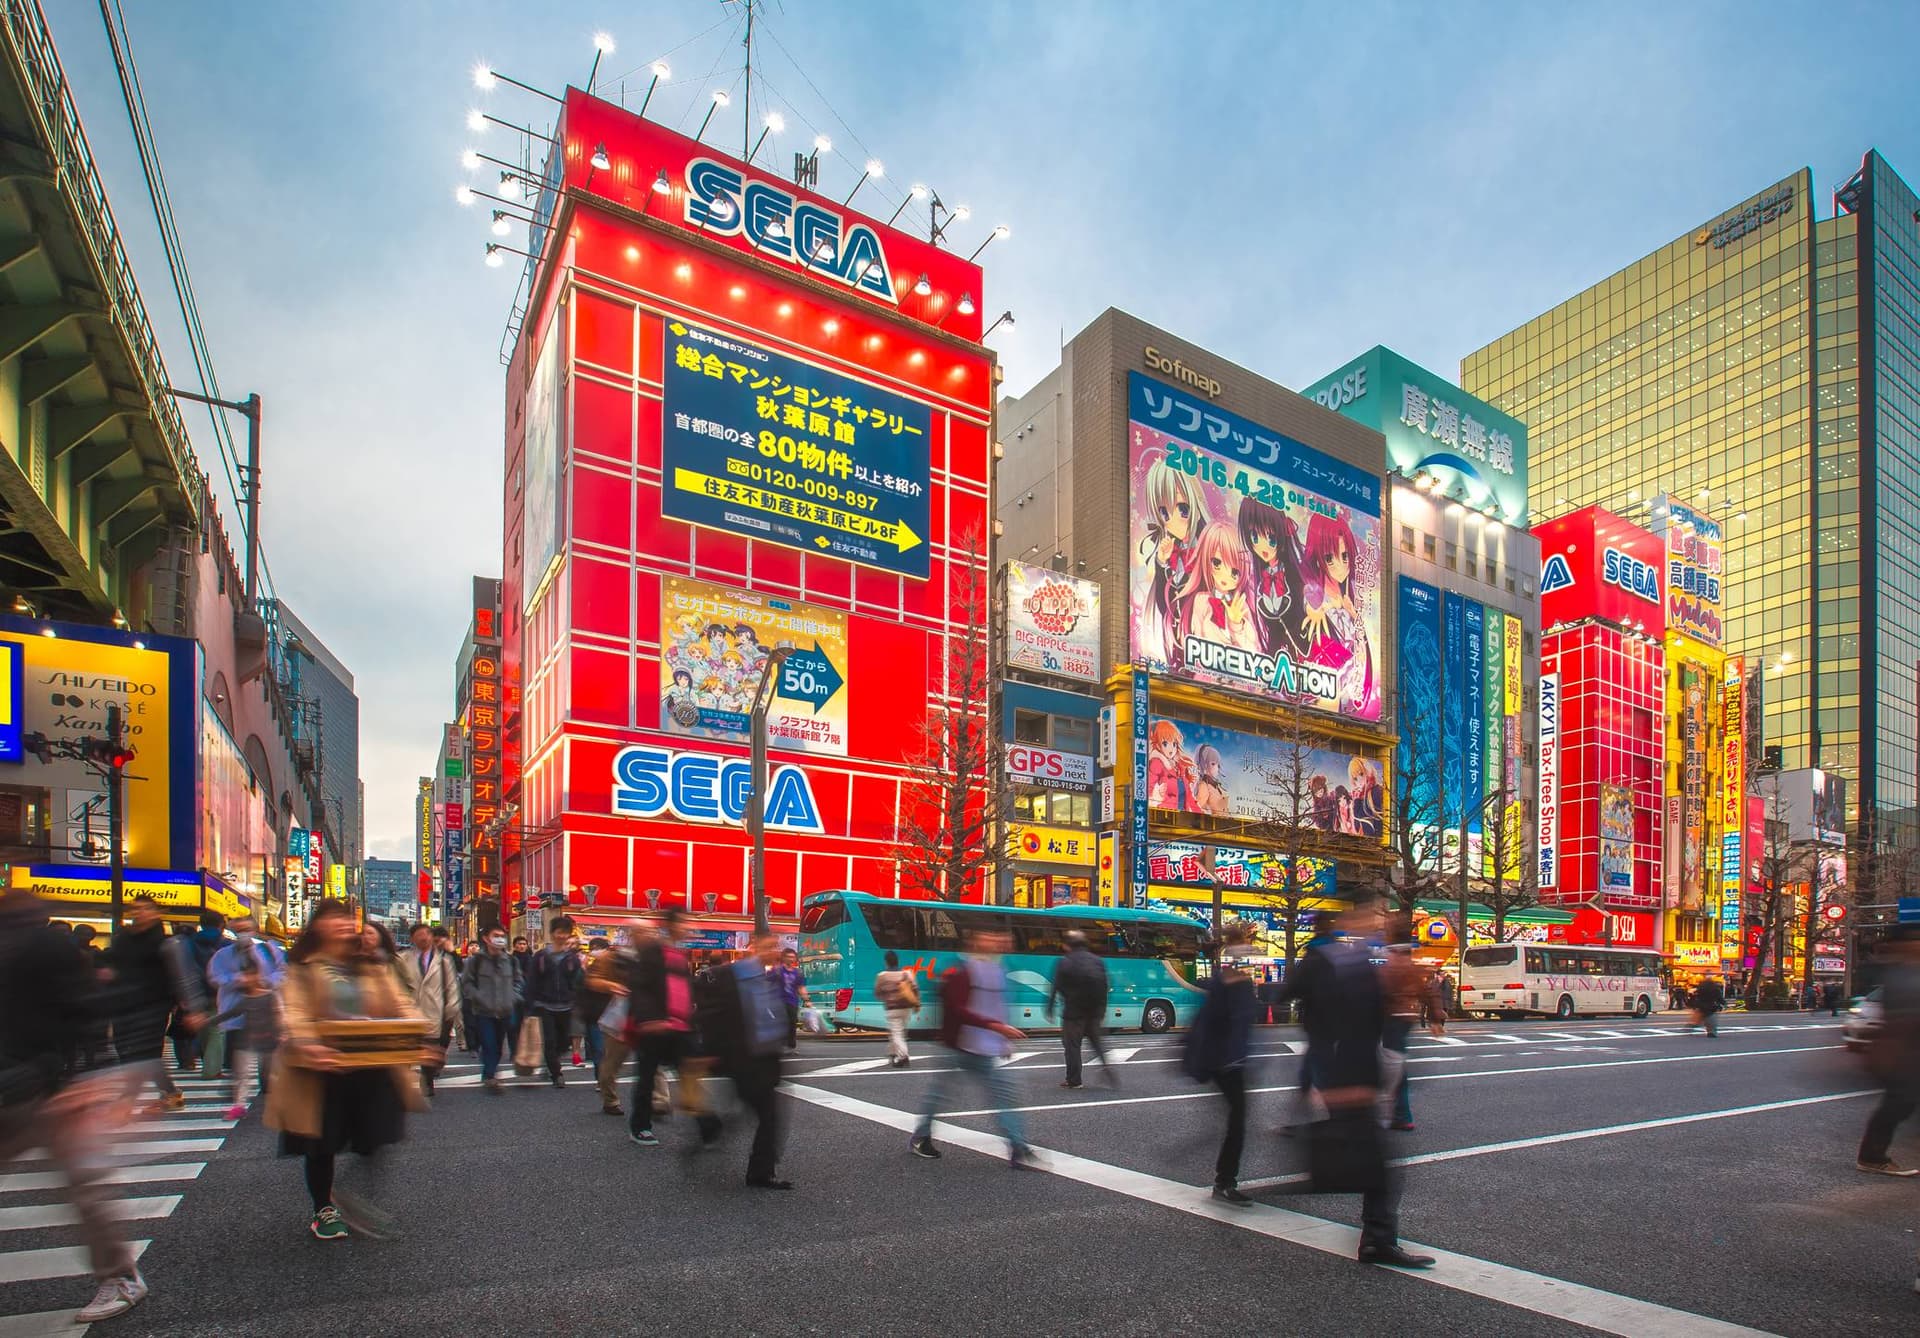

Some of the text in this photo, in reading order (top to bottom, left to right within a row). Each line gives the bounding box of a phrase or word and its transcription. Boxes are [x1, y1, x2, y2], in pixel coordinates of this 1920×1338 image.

[684, 157, 899, 305] SEGA
[1145, 347, 1222, 396] Sofmap
[675, 344, 922, 435] 総合マンションギャラリー
[756, 396, 855, 445] 秋葉原館
[1144, 387, 1281, 464] ソフマップ
[751, 464, 878, 511] 0120-009-897
[704, 478, 898, 539] 住友不動産秋葉原ビル8F
[1308, 498, 1338, 519] SALE
[1603, 547, 1660, 605] SEGA
[1671, 562, 1719, 603] 高額買取
[1016, 630, 1034, 644] BIG
[784, 657, 827, 672] ここから
[38, 672, 156, 696] SHISEIDO
[784, 671, 828, 694] 50m
[1541, 679, 1555, 722] AKKY
[54, 714, 143, 735] Kanbo
[780, 716, 830, 731] クラブセガ
[1008, 748, 1063, 776] GPS
[1065, 770, 1087, 780] next
[1541, 738, 1555, 802] Tax-free
[612, 745, 825, 833] SEGA
[1540, 804, 1555, 846] Shop
[1669, 800, 1678, 824] GAME
[1048, 838, 1079, 855] 松屋
[310, 856, 319, 880] KFC
[32, 884, 111, 897] Matsumot
[1102, 879, 1112, 907] 松屋
[1620, 915, 1636, 942] SEGA
[1545, 977, 1626, 992] YUNAGI
